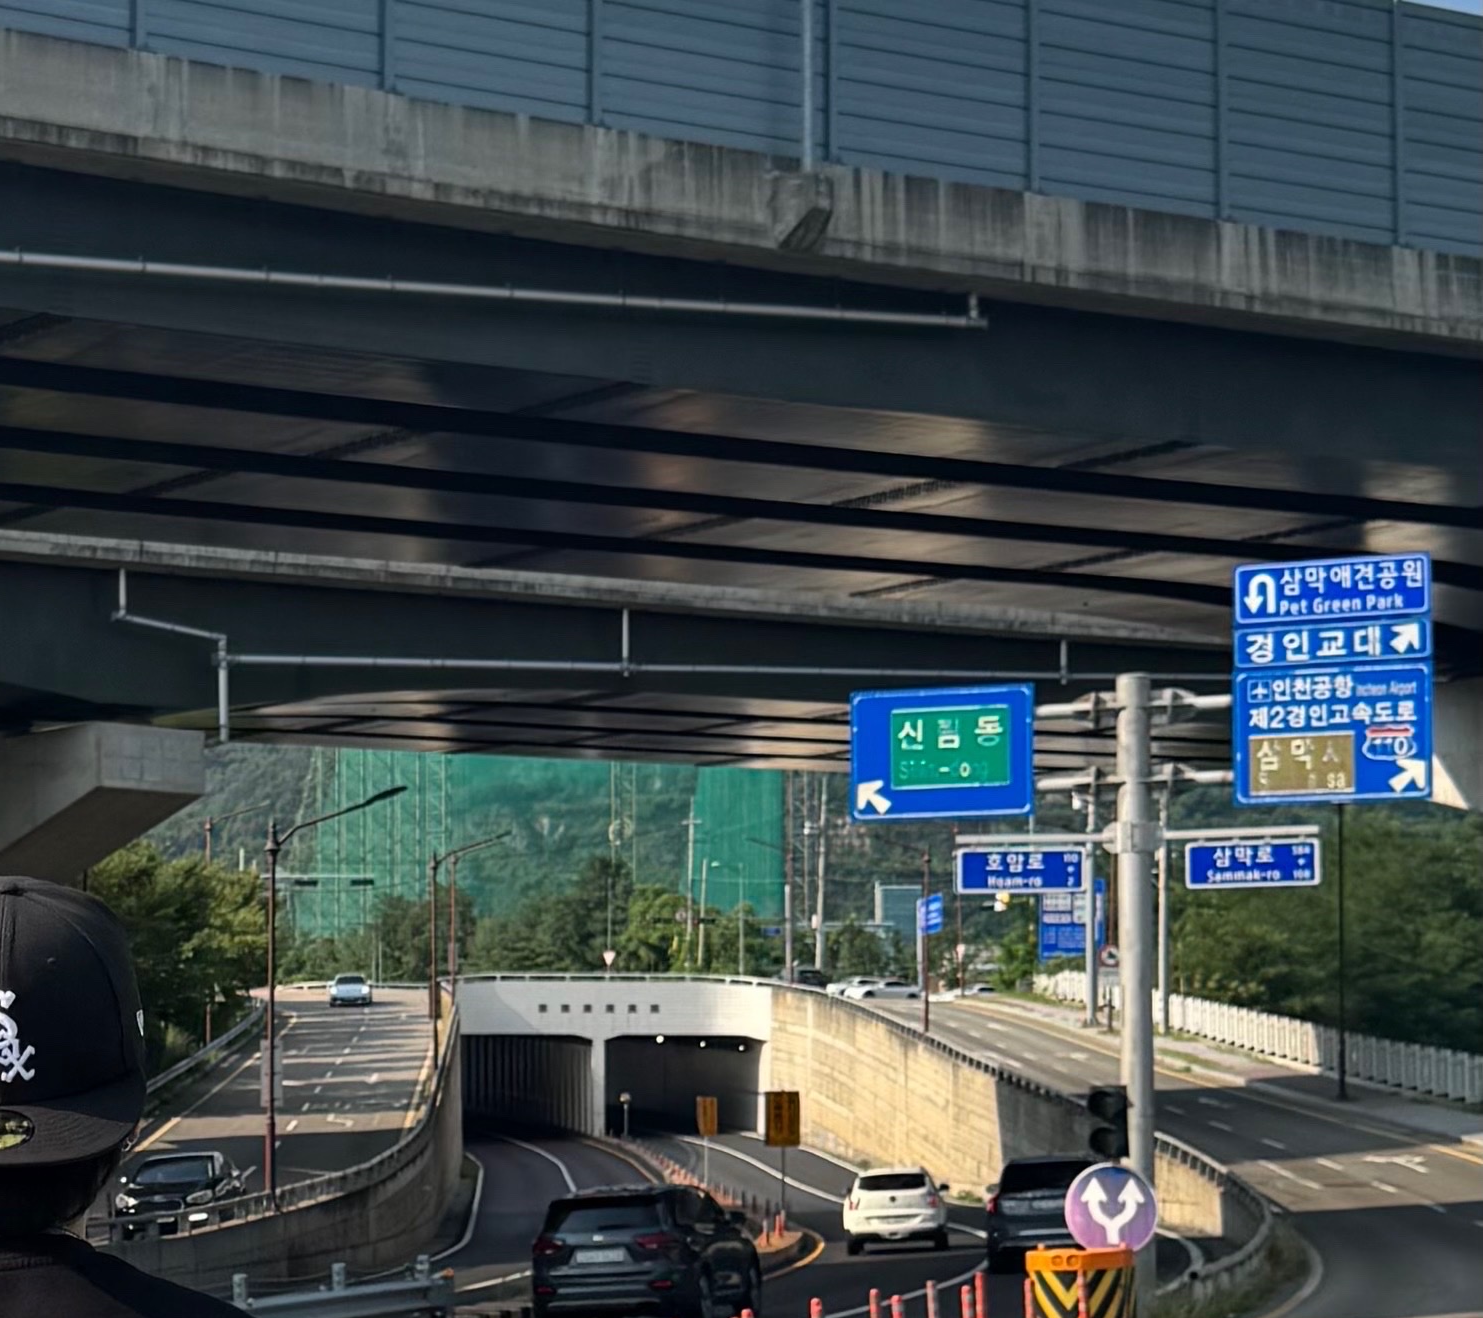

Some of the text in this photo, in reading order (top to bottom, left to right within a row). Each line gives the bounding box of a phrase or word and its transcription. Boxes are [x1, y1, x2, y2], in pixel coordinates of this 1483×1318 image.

[1279, 560, 1424, 597] 삼막애견공원
[1279, 593, 1404, 616] Pet Green Park
[1246, 624, 1382, 664] 경인교대
[1272, 675, 1354, 701] 인천공항
[1248, 700, 1418, 729] 제2경인고속도로
[897, 715, 1004, 751] 신림동
[985, 853, 1045, 873] 호암로
[1213, 845, 1275, 868] 삼막로
[1206, 869, 1281, 883] Sammak-ro
